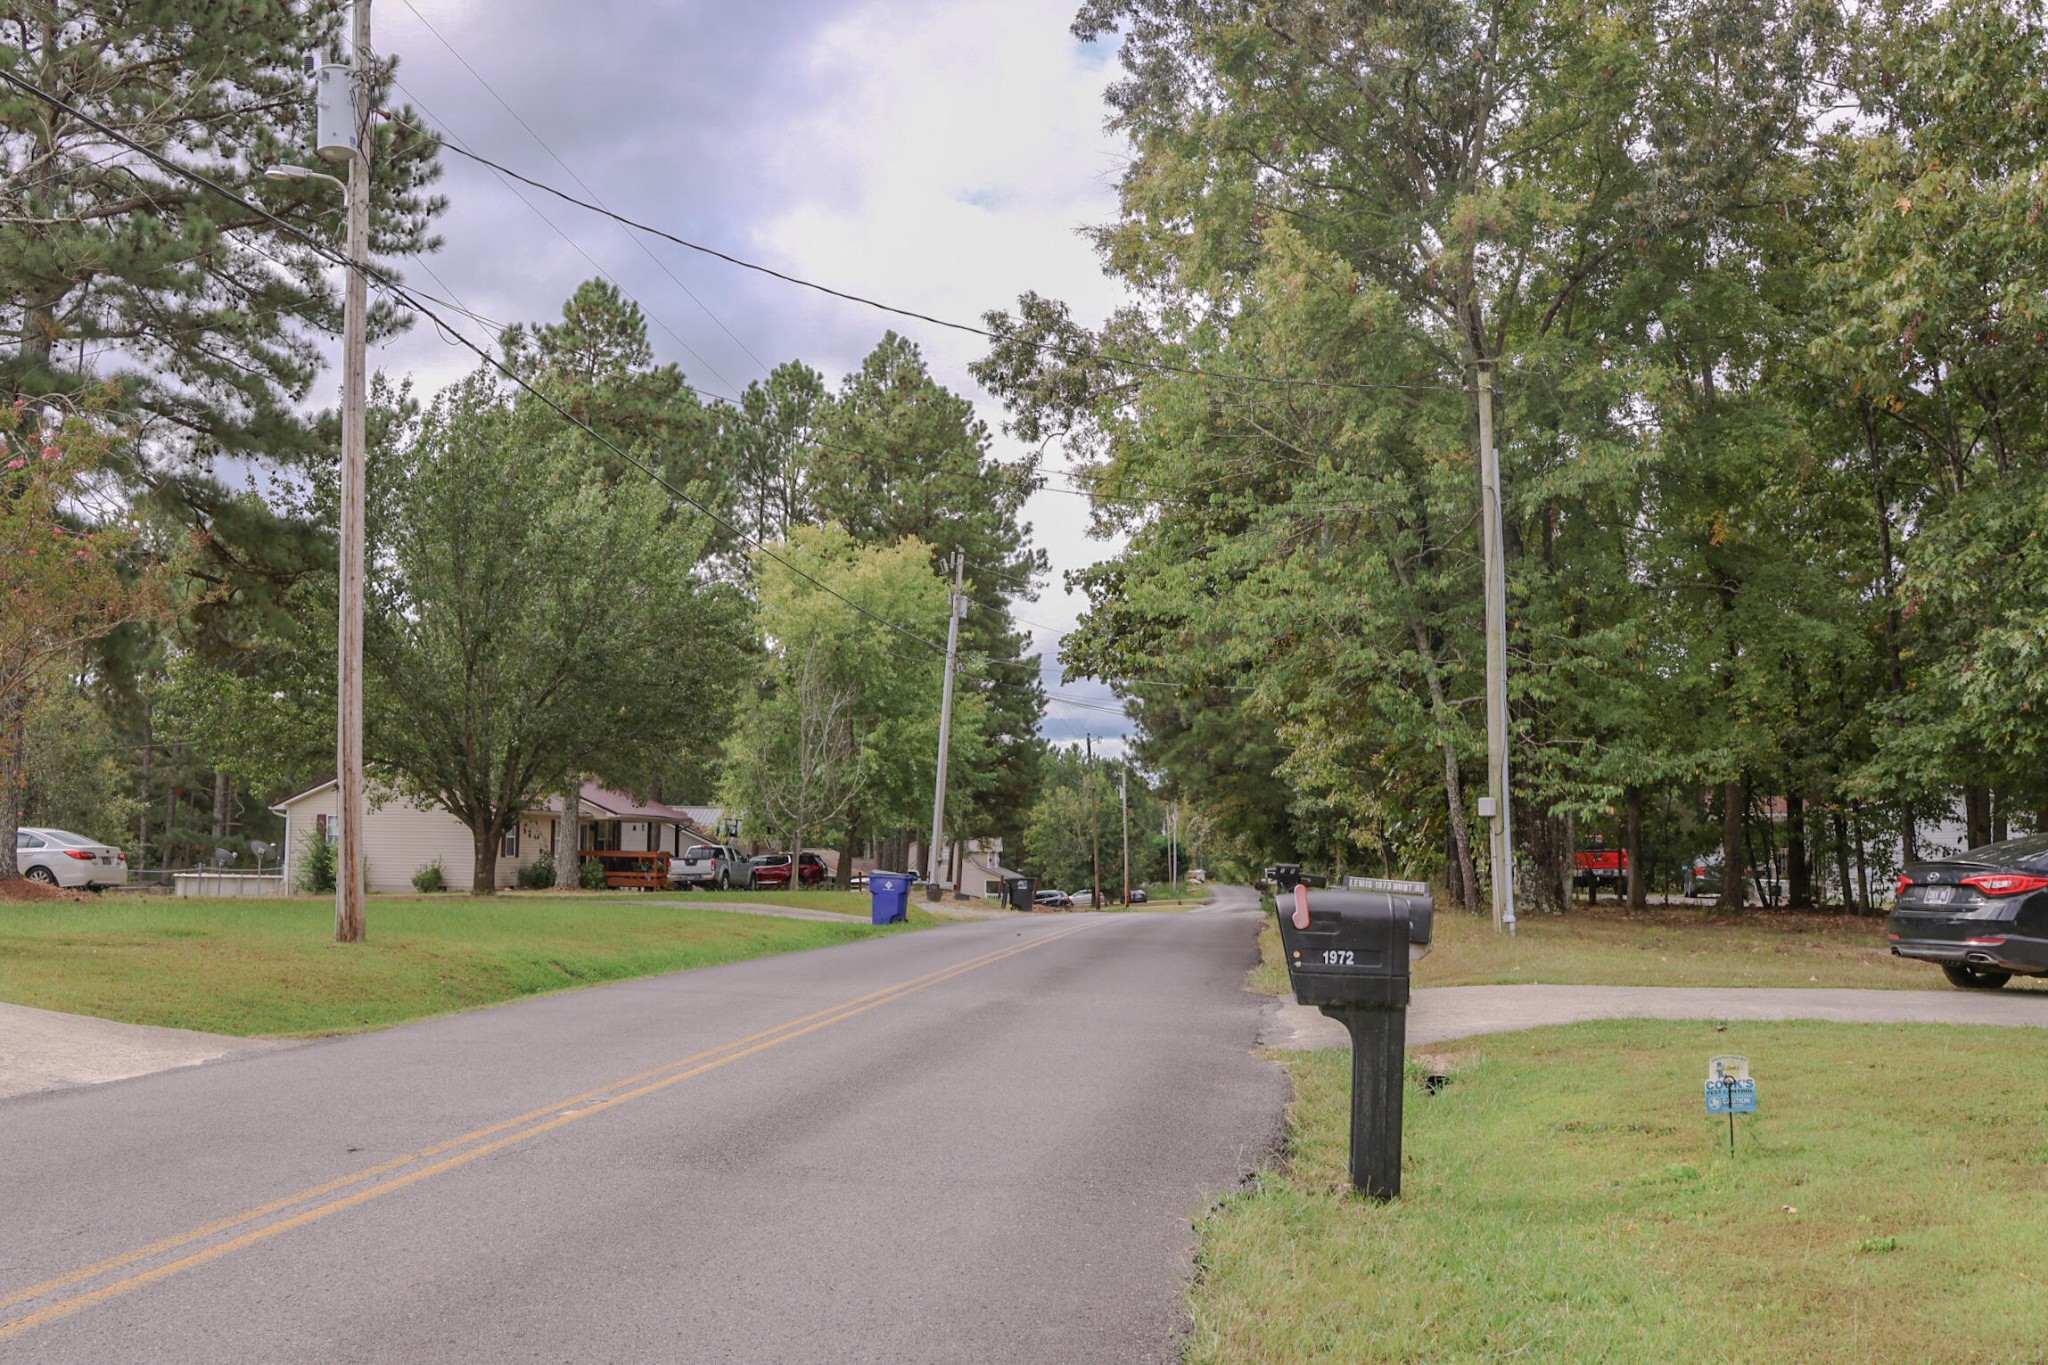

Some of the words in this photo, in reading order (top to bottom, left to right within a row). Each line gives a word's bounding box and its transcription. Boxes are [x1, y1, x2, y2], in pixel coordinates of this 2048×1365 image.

[1349, 879, 1373, 888] LEWIS
[1375, 881, 1391, 890] 1973
[1323, 950, 1354, 965] 1972
